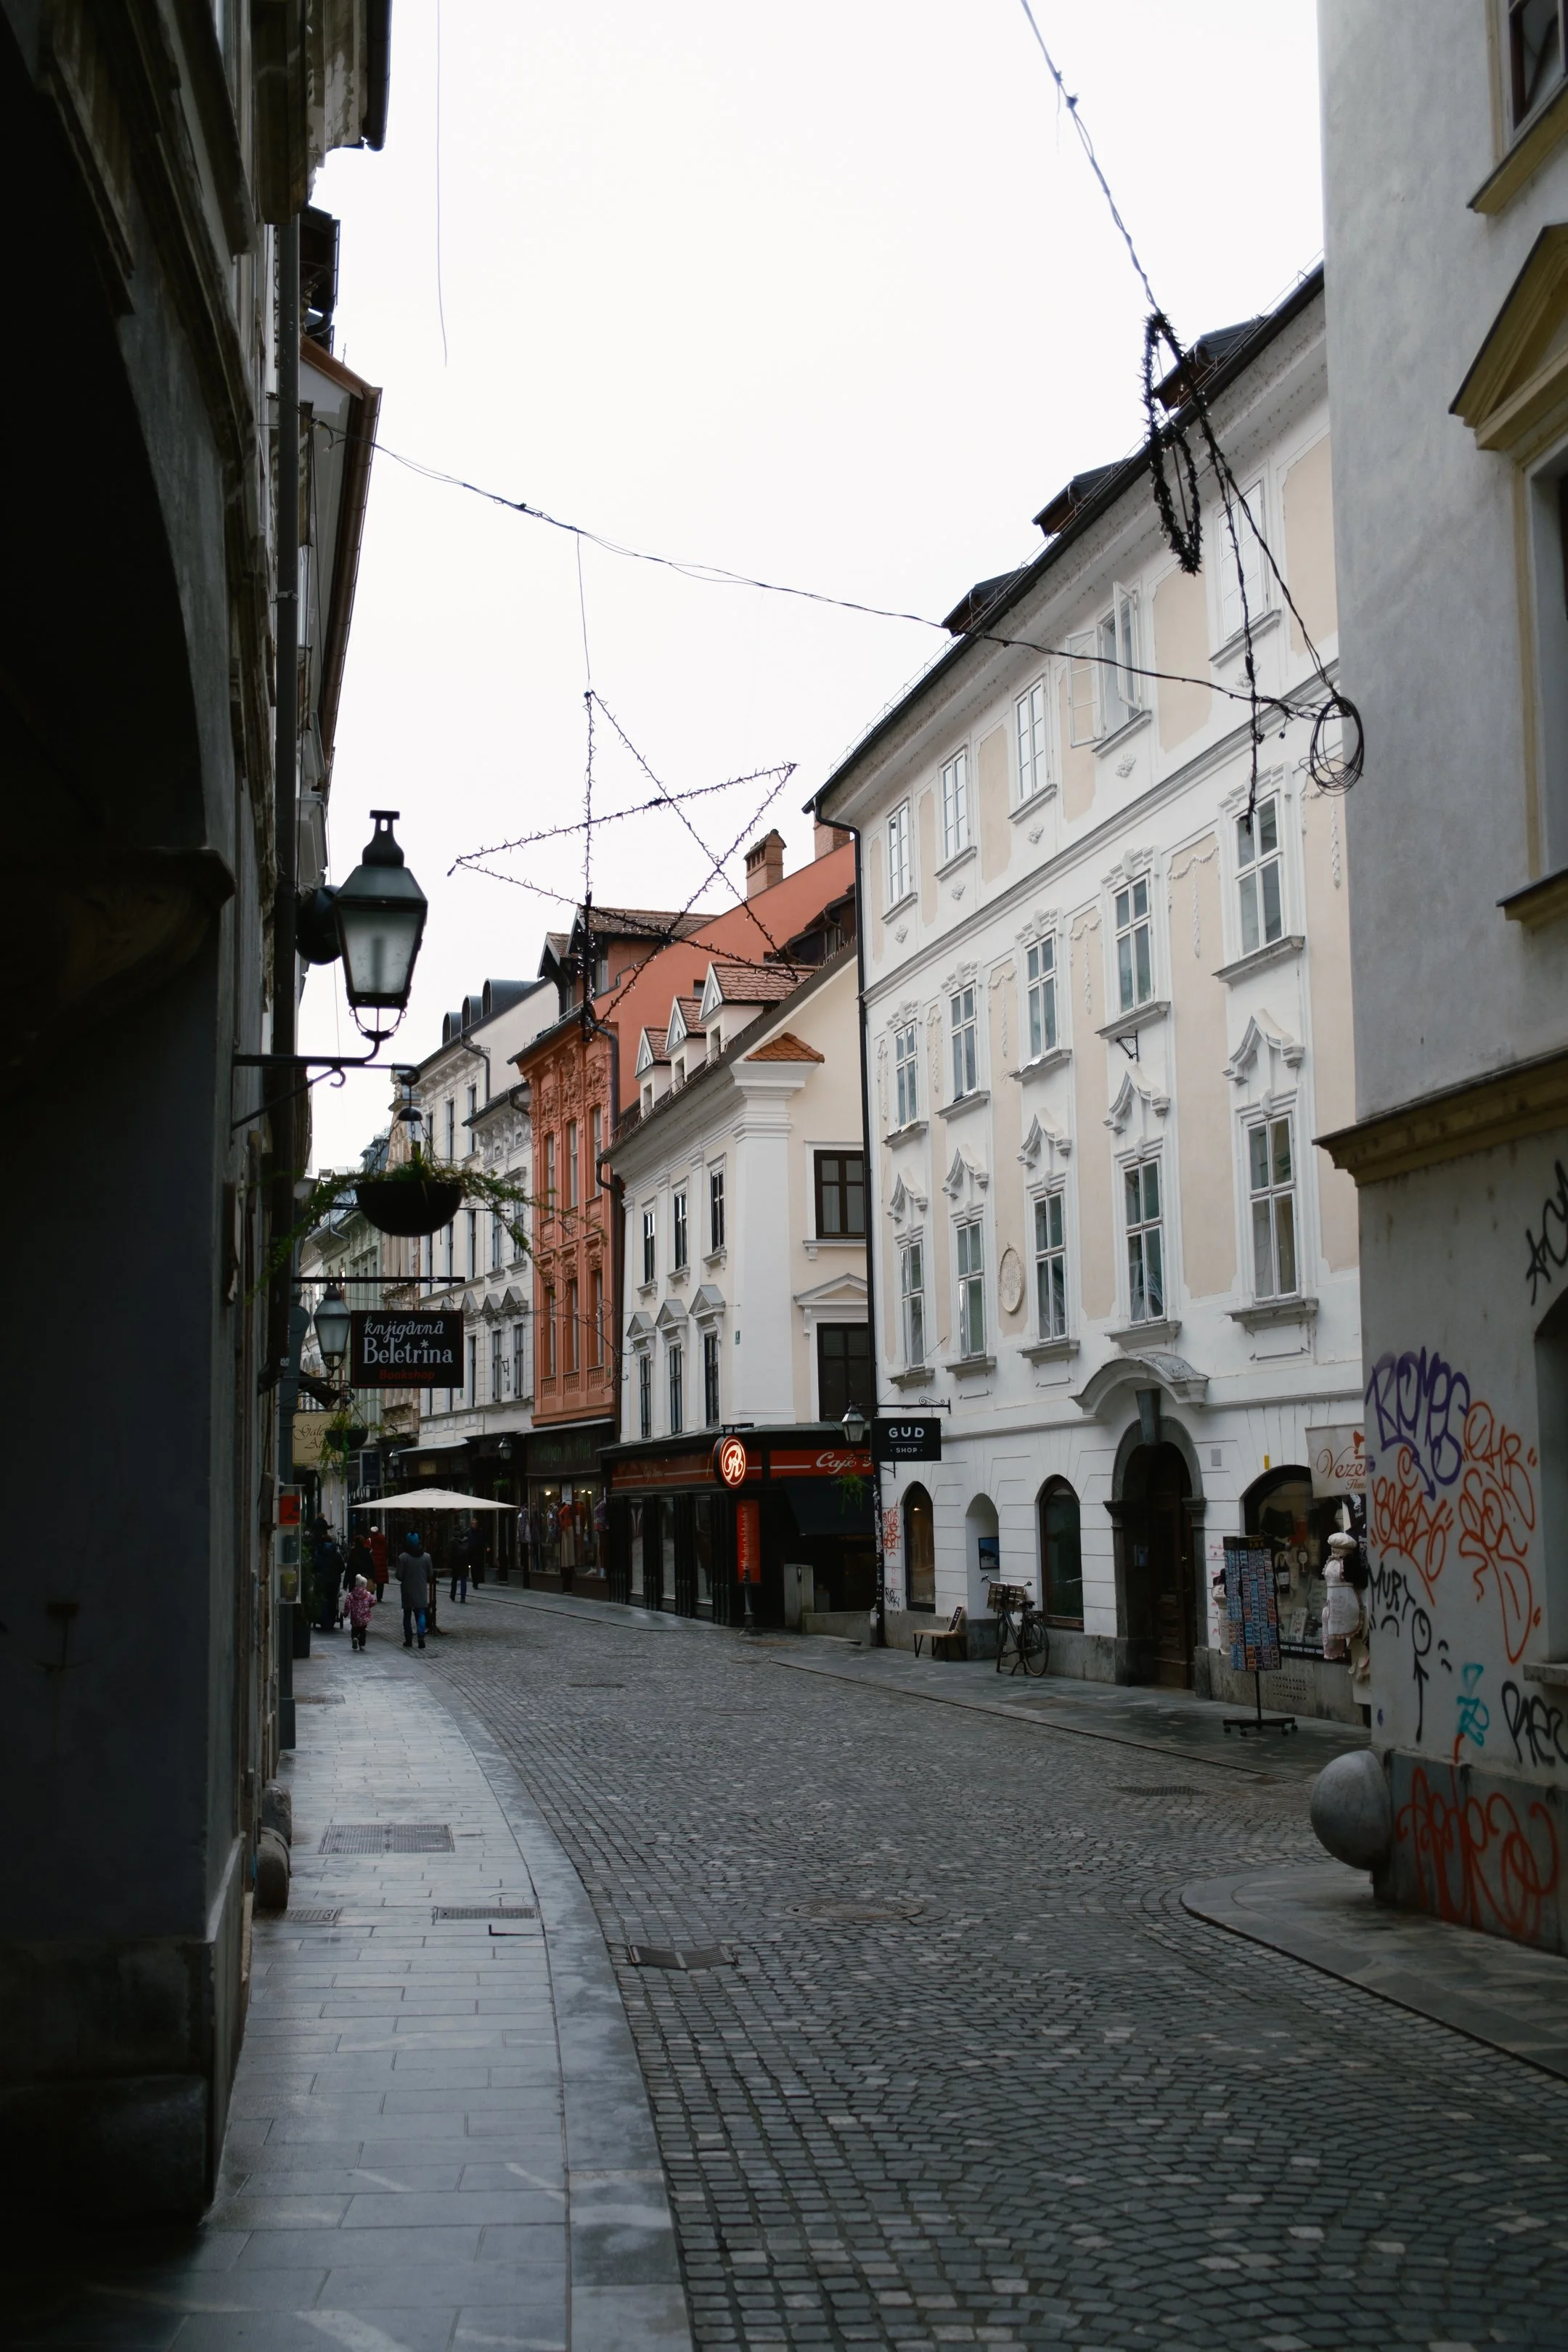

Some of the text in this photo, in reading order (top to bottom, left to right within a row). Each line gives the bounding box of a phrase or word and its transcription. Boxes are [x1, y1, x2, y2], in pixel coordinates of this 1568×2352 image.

[363, 1315, 444, 1343] knjigarna
[363, 1336, 454, 1365] Beletrina
[379, 1369, 436, 1381] Bookshop
[888, 1426, 926, 1439] GUD
